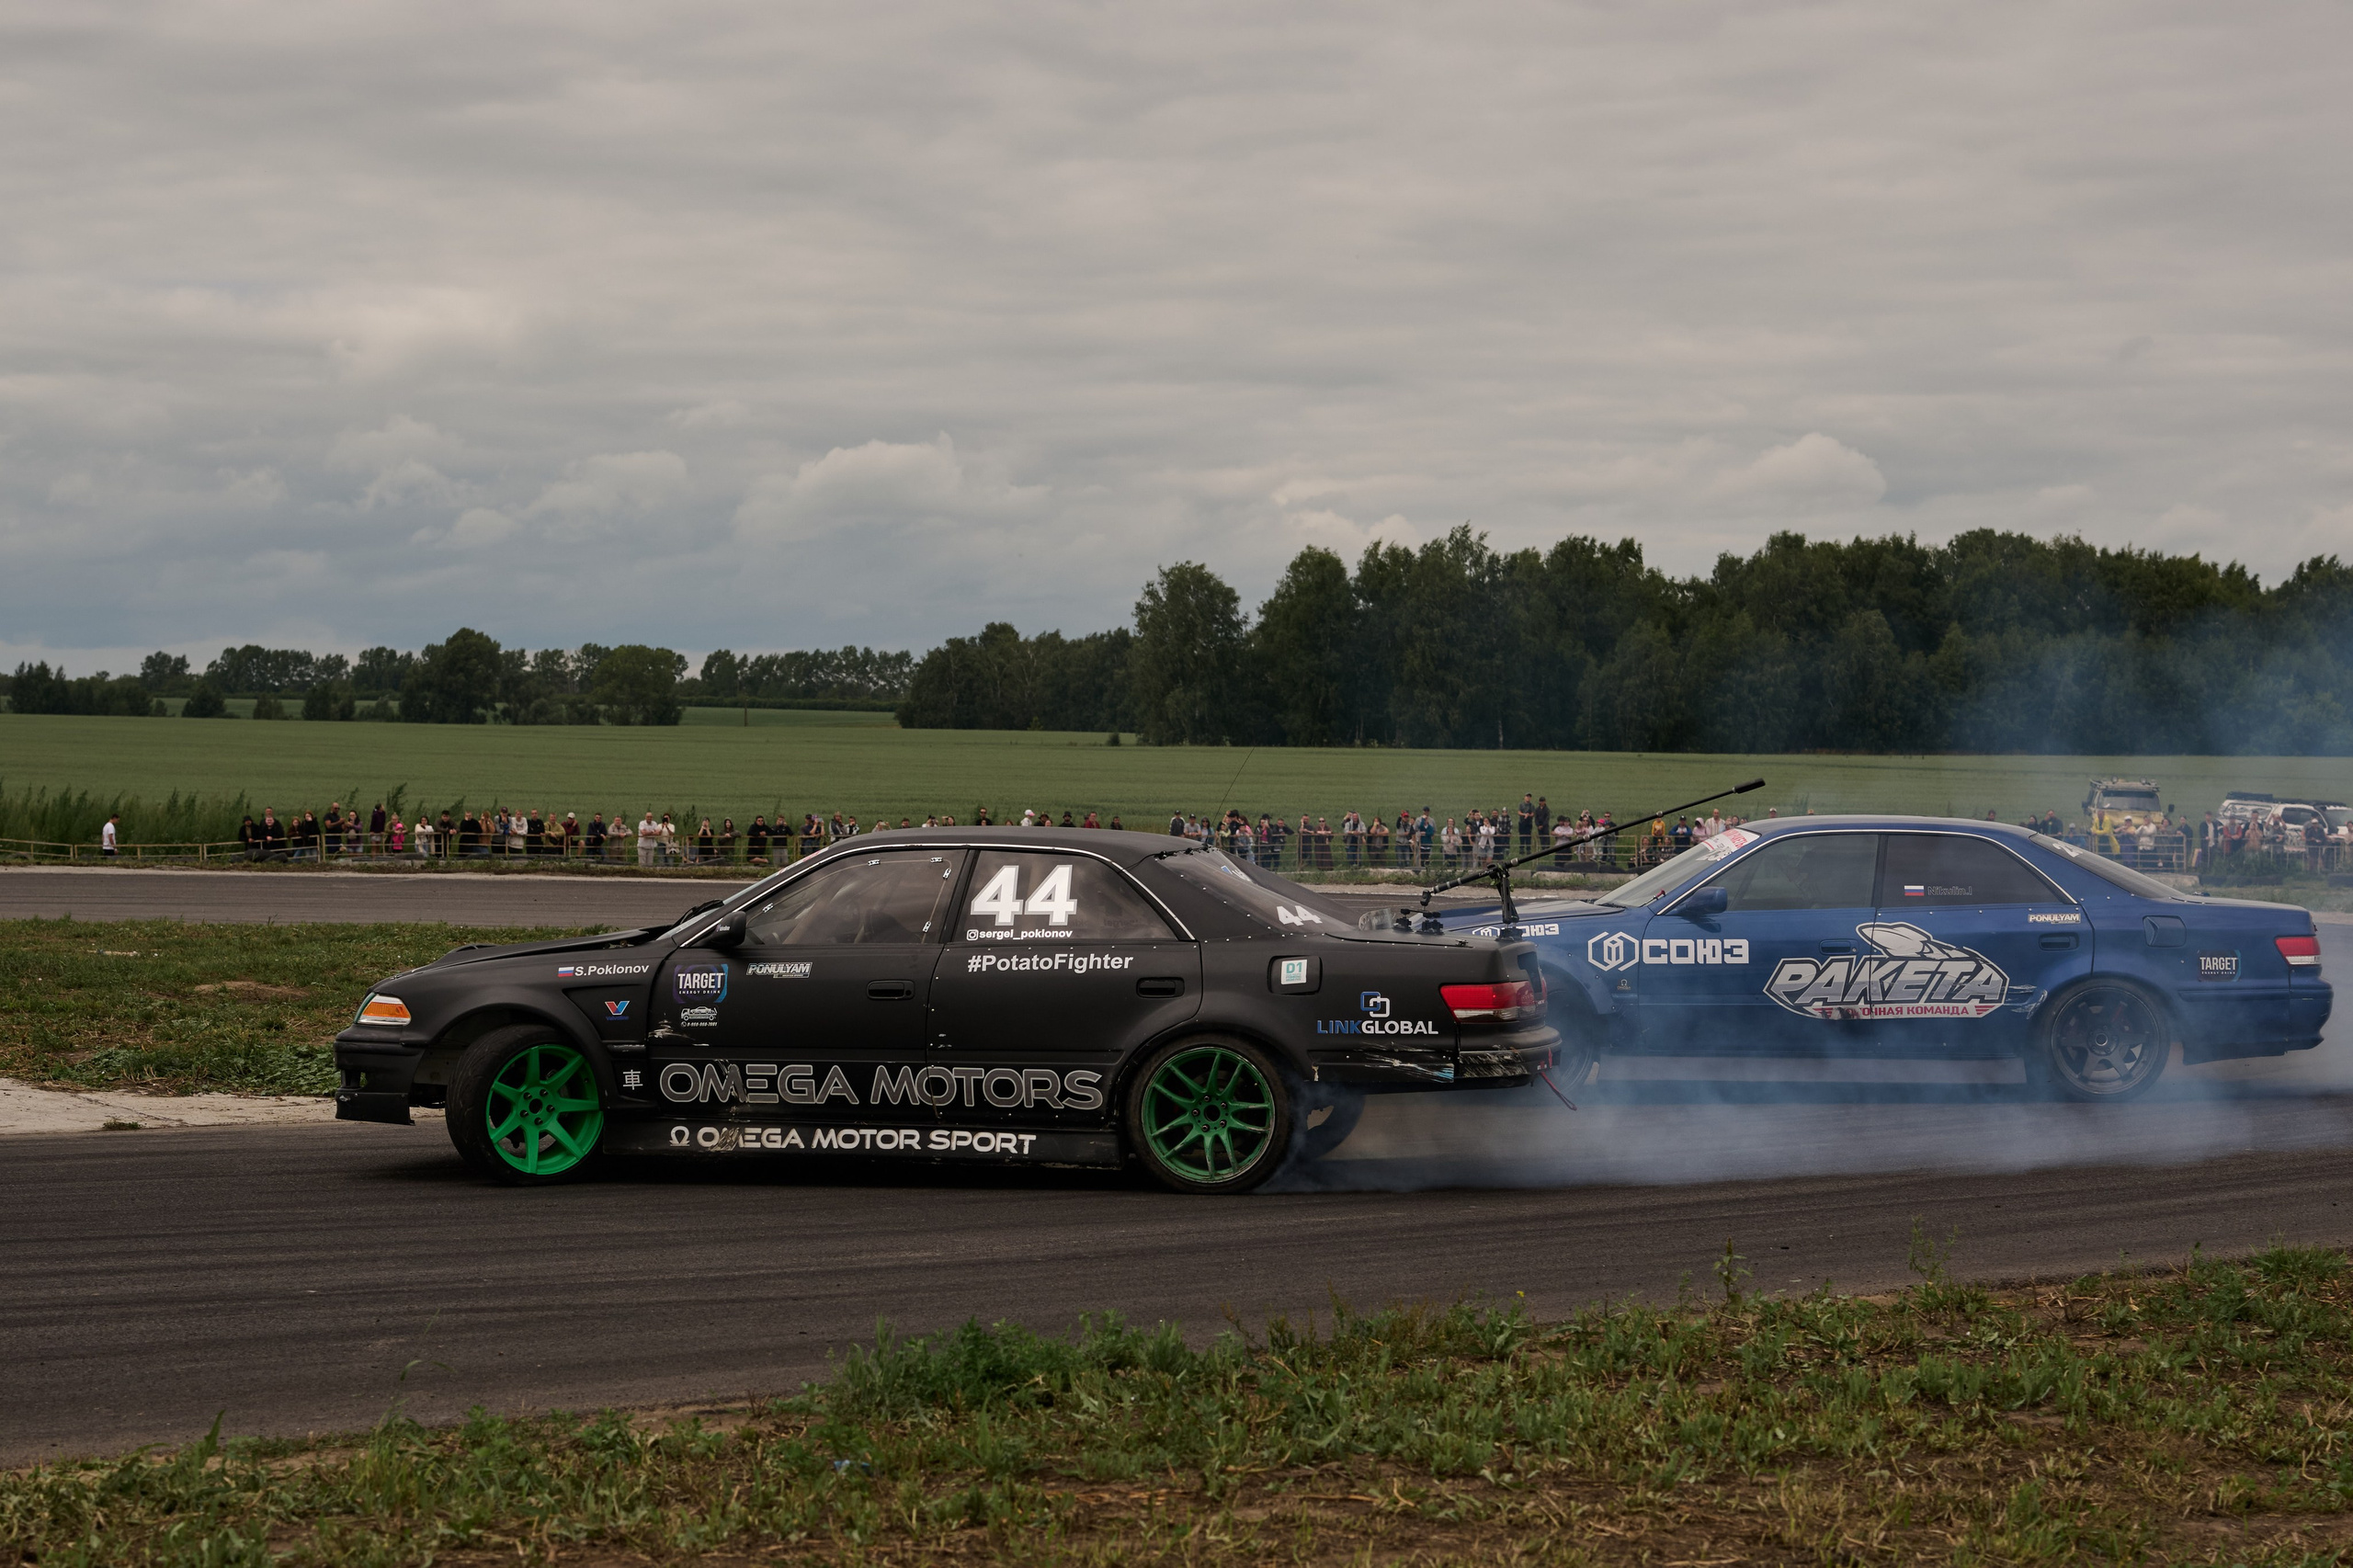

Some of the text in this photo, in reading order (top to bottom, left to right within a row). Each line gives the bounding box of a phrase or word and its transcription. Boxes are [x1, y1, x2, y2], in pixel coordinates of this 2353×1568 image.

[970, 864, 1078, 926] 44
[1276, 905, 1323, 926] 44
[1643, 938, 1749, 964] СОЮЗ
[574, 964, 650, 977] S.Poklonov
[747, 963, 812, 974] PONULYAM
[968, 953, 1134, 974] #PotatoFighter
[1287, 961, 1302, 974] D1
[2200, 957, 2238, 971] TARGET
[677, 972, 722, 989] TARGET
[1770, 960, 2004, 1005] РАКЕТА
[1906, 1006, 1969, 1016] КОМАНДА
[1317, 1019, 1439, 1035] LINKGLOBAL
[622, 1069, 643, 1090] 車
[660, 1062, 1103, 1110] OMEGA MOTORS
[811, 1128, 921, 1150] MOTOR
[927, 1130, 1037, 1154] SPORT
